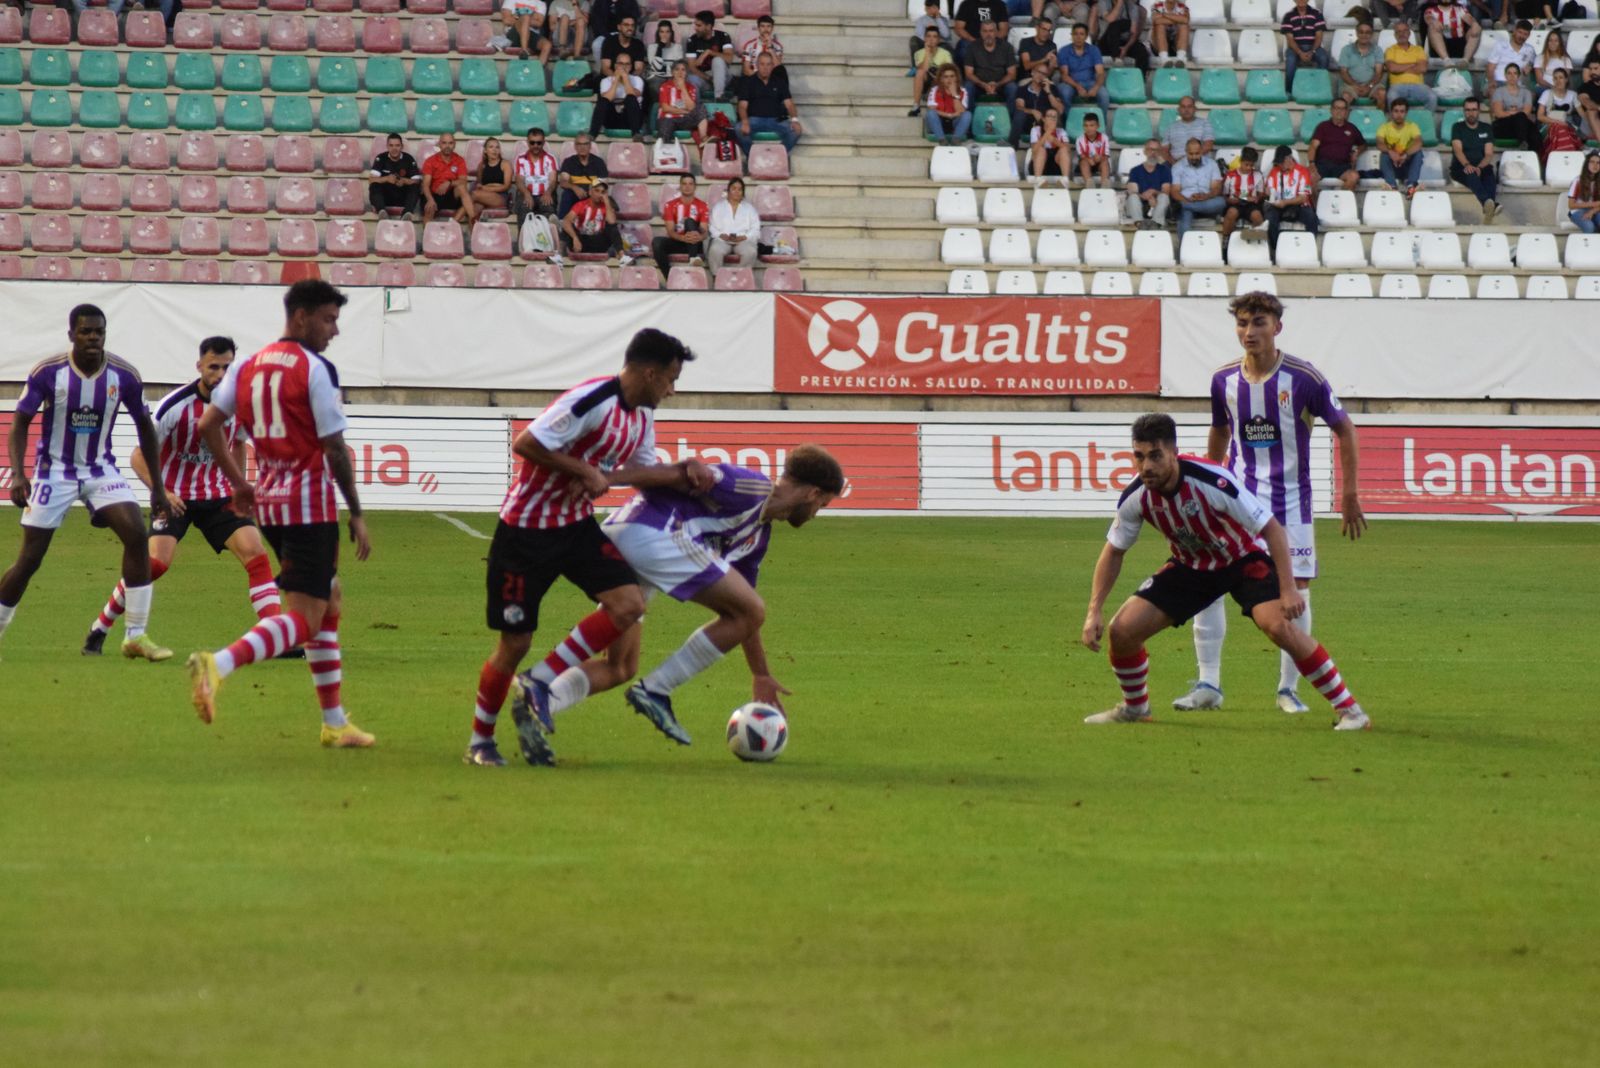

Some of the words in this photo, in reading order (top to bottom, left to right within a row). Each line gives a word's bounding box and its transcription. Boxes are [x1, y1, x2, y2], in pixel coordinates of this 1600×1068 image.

[895, 311, 1129, 364] Cualtis
[800, 374, 917, 388] PREVENCIÓN.
[925, 377, 987, 388] SALUD.
[996, 377, 1135, 390] TRANQUILIDAD.
[250, 370, 286, 439] 11
[31, 483, 52, 505] 18
